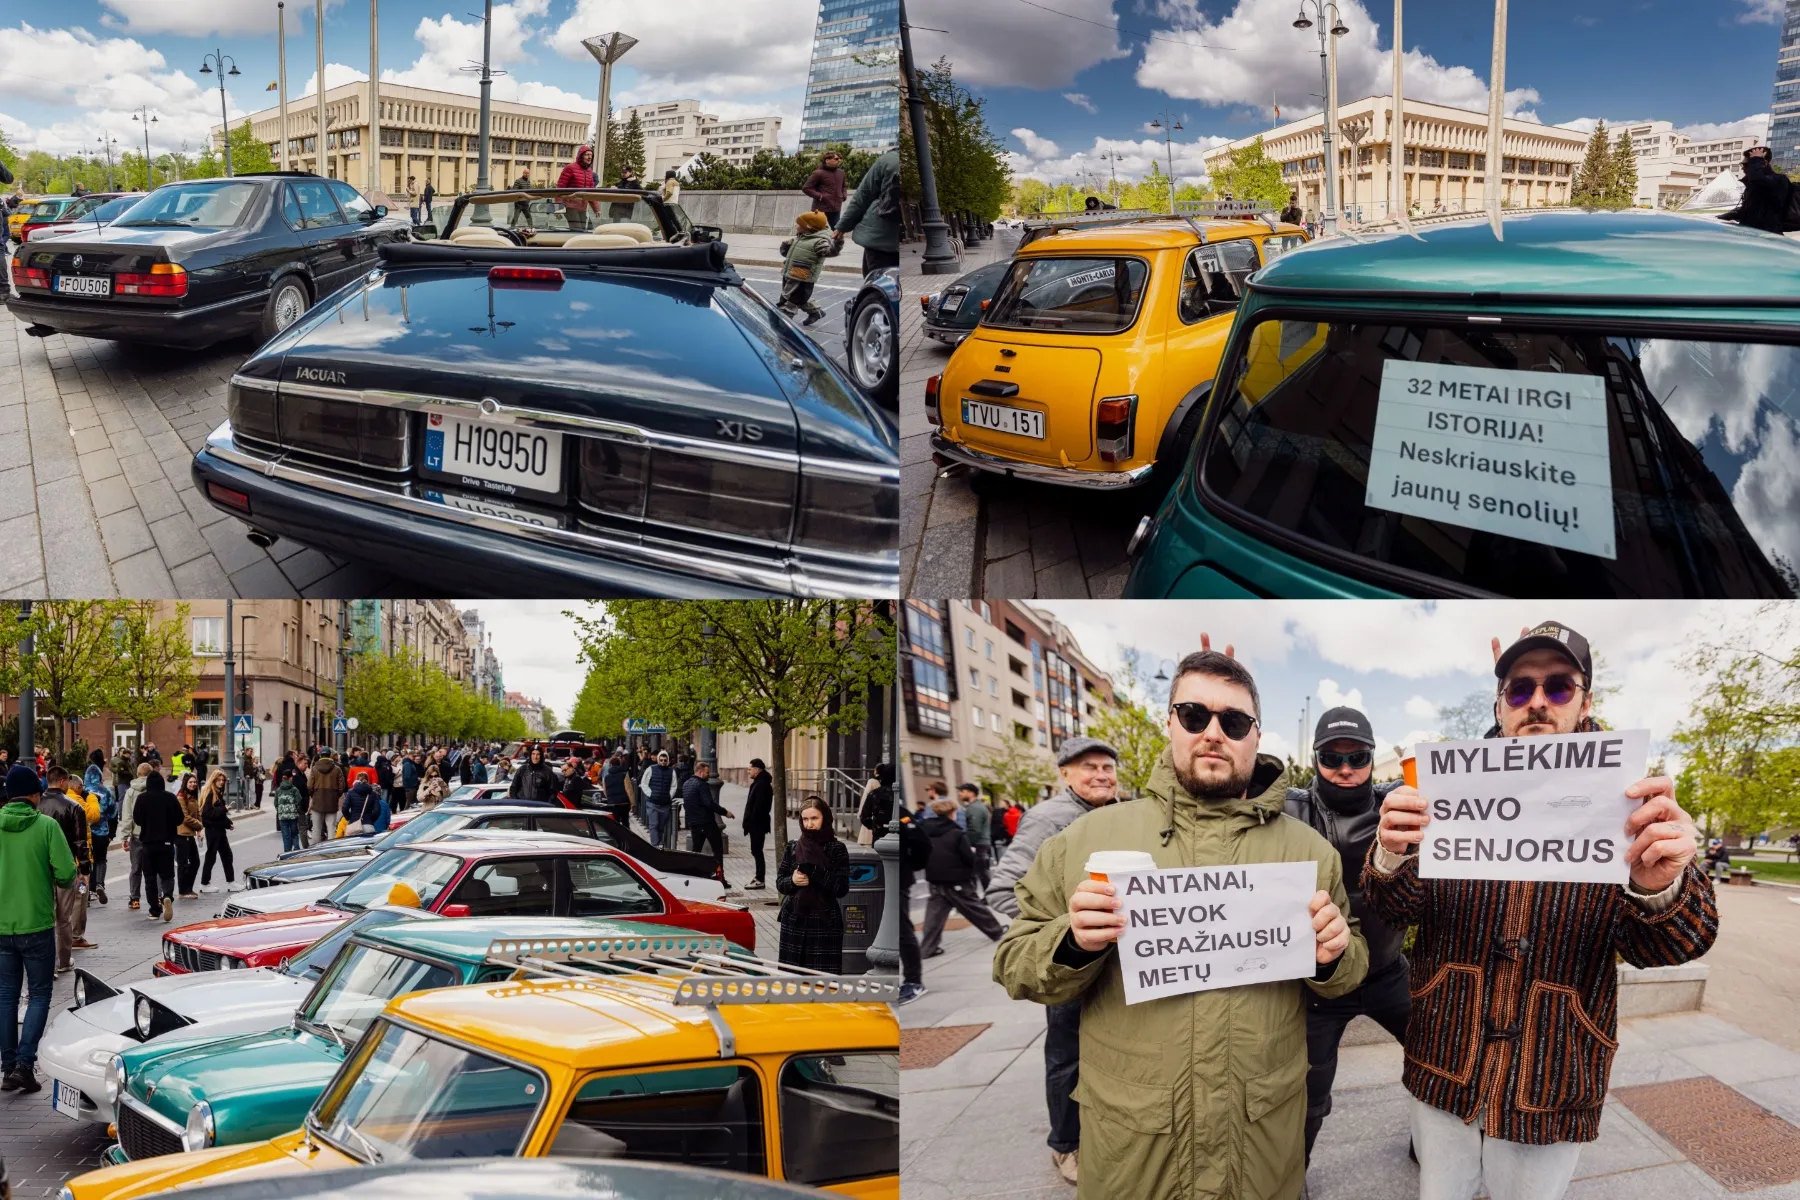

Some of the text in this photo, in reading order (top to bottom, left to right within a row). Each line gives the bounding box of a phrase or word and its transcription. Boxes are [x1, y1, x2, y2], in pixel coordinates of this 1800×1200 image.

[64, 278, 108, 293] FOU506
[1070, 269, 1115, 286] MONTE-CARLO
[295, 366, 346, 384] JAGUAR
[1407, 378, 1571, 411] 32 METAI IRGI
[716, 419, 763, 441] XJS
[969, 403, 1039, 436] TVU 151
[1427, 411, 1544, 443] ISTORIJA!
[427, 455, 440, 467] LT
[454, 422, 548, 477] H19950
[1399, 441, 1577, 487] Neskriauskite
[462, 476, 516, 495] Drive Tastefully
[1391, 475, 1579, 533] jaunų senolių!
[1430, 738, 1624, 775] MYLĖKIME
[1433, 797, 1521, 821] SAVO
[1432, 837, 1615, 863] SENJORUS
[1126, 870, 1254, 896] ANTANAI,
[1130, 904, 1227, 928] NEVOK
[1134, 926, 1291, 958] GRAŽIAUSIŲ
[1139, 963, 1211, 988] METŲ
